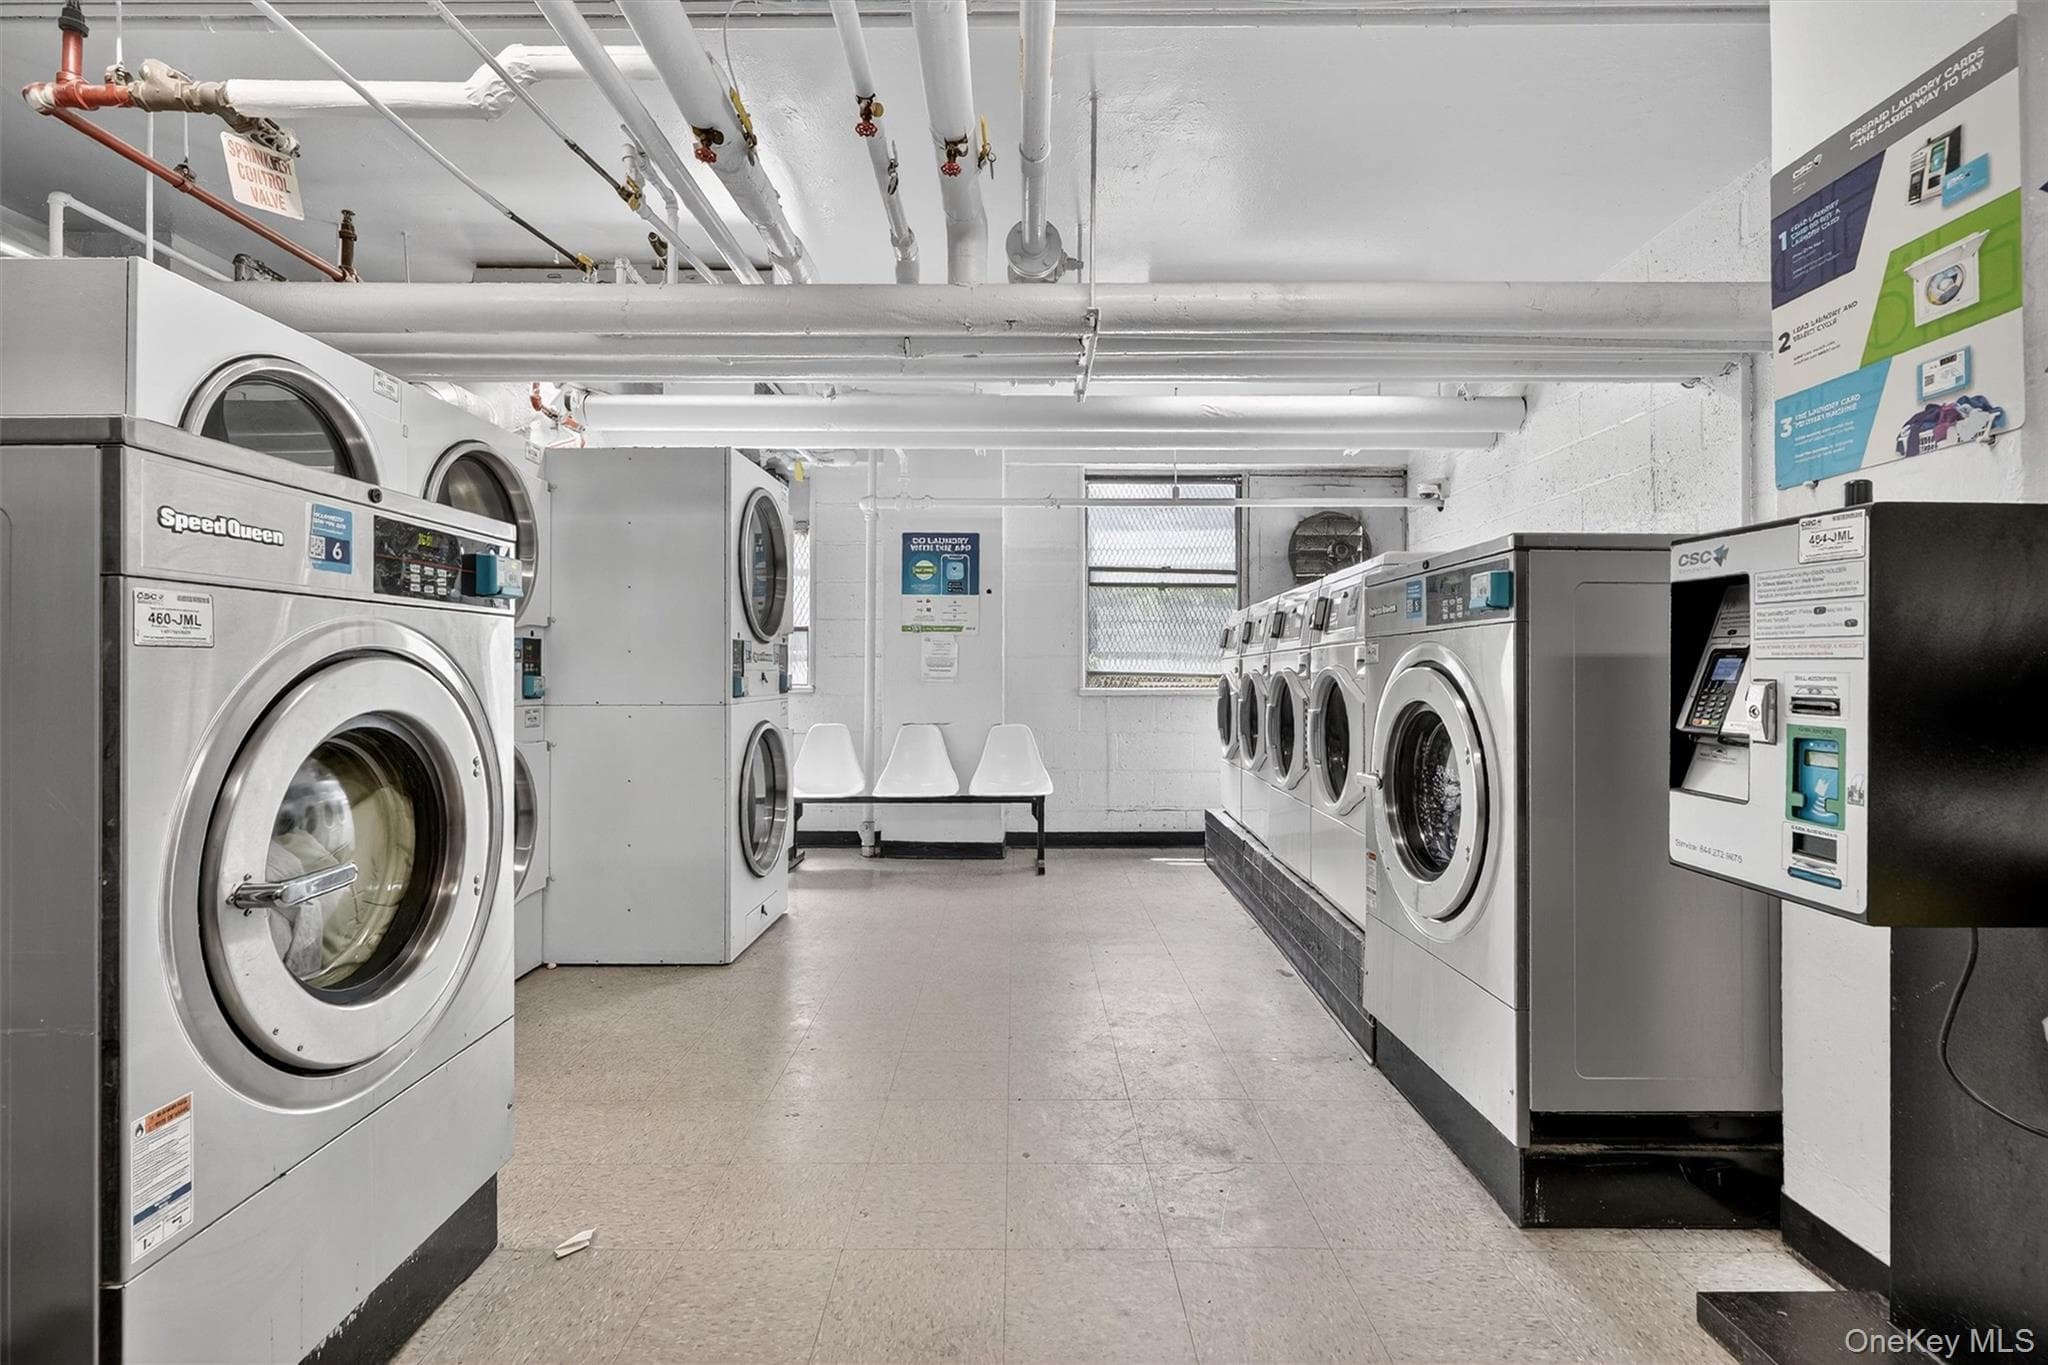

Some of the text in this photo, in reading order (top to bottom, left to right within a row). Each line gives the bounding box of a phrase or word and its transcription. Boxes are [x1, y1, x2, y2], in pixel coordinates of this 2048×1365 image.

[1850, 46, 1984, 142] PREPAID LAUNDRY CARDS
[1878, 105, 1913, 133] EASIER
[1915, 87, 1941, 109] WAY
[1943, 76, 1959, 91] TO
[1961, 58, 1984, 80] PAY
[237, 162, 291, 194] CONTROL
[250, 186, 287, 211] VALVE
[1778, 231, 1787, 251] 1
[1843, 300, 1858, 312] AND
[1778, 331, 1791, 354] 2
[1780, 416, 1792, 438] 3
[332, 542, 343, 560] 6
[910, 544, 972, 552] WITH THE APP
[927, 537, 969, 545] LAUNDRY
[1679, 550, 1712, 567] CSC
[148, 612, 202, 626] 460-JML
